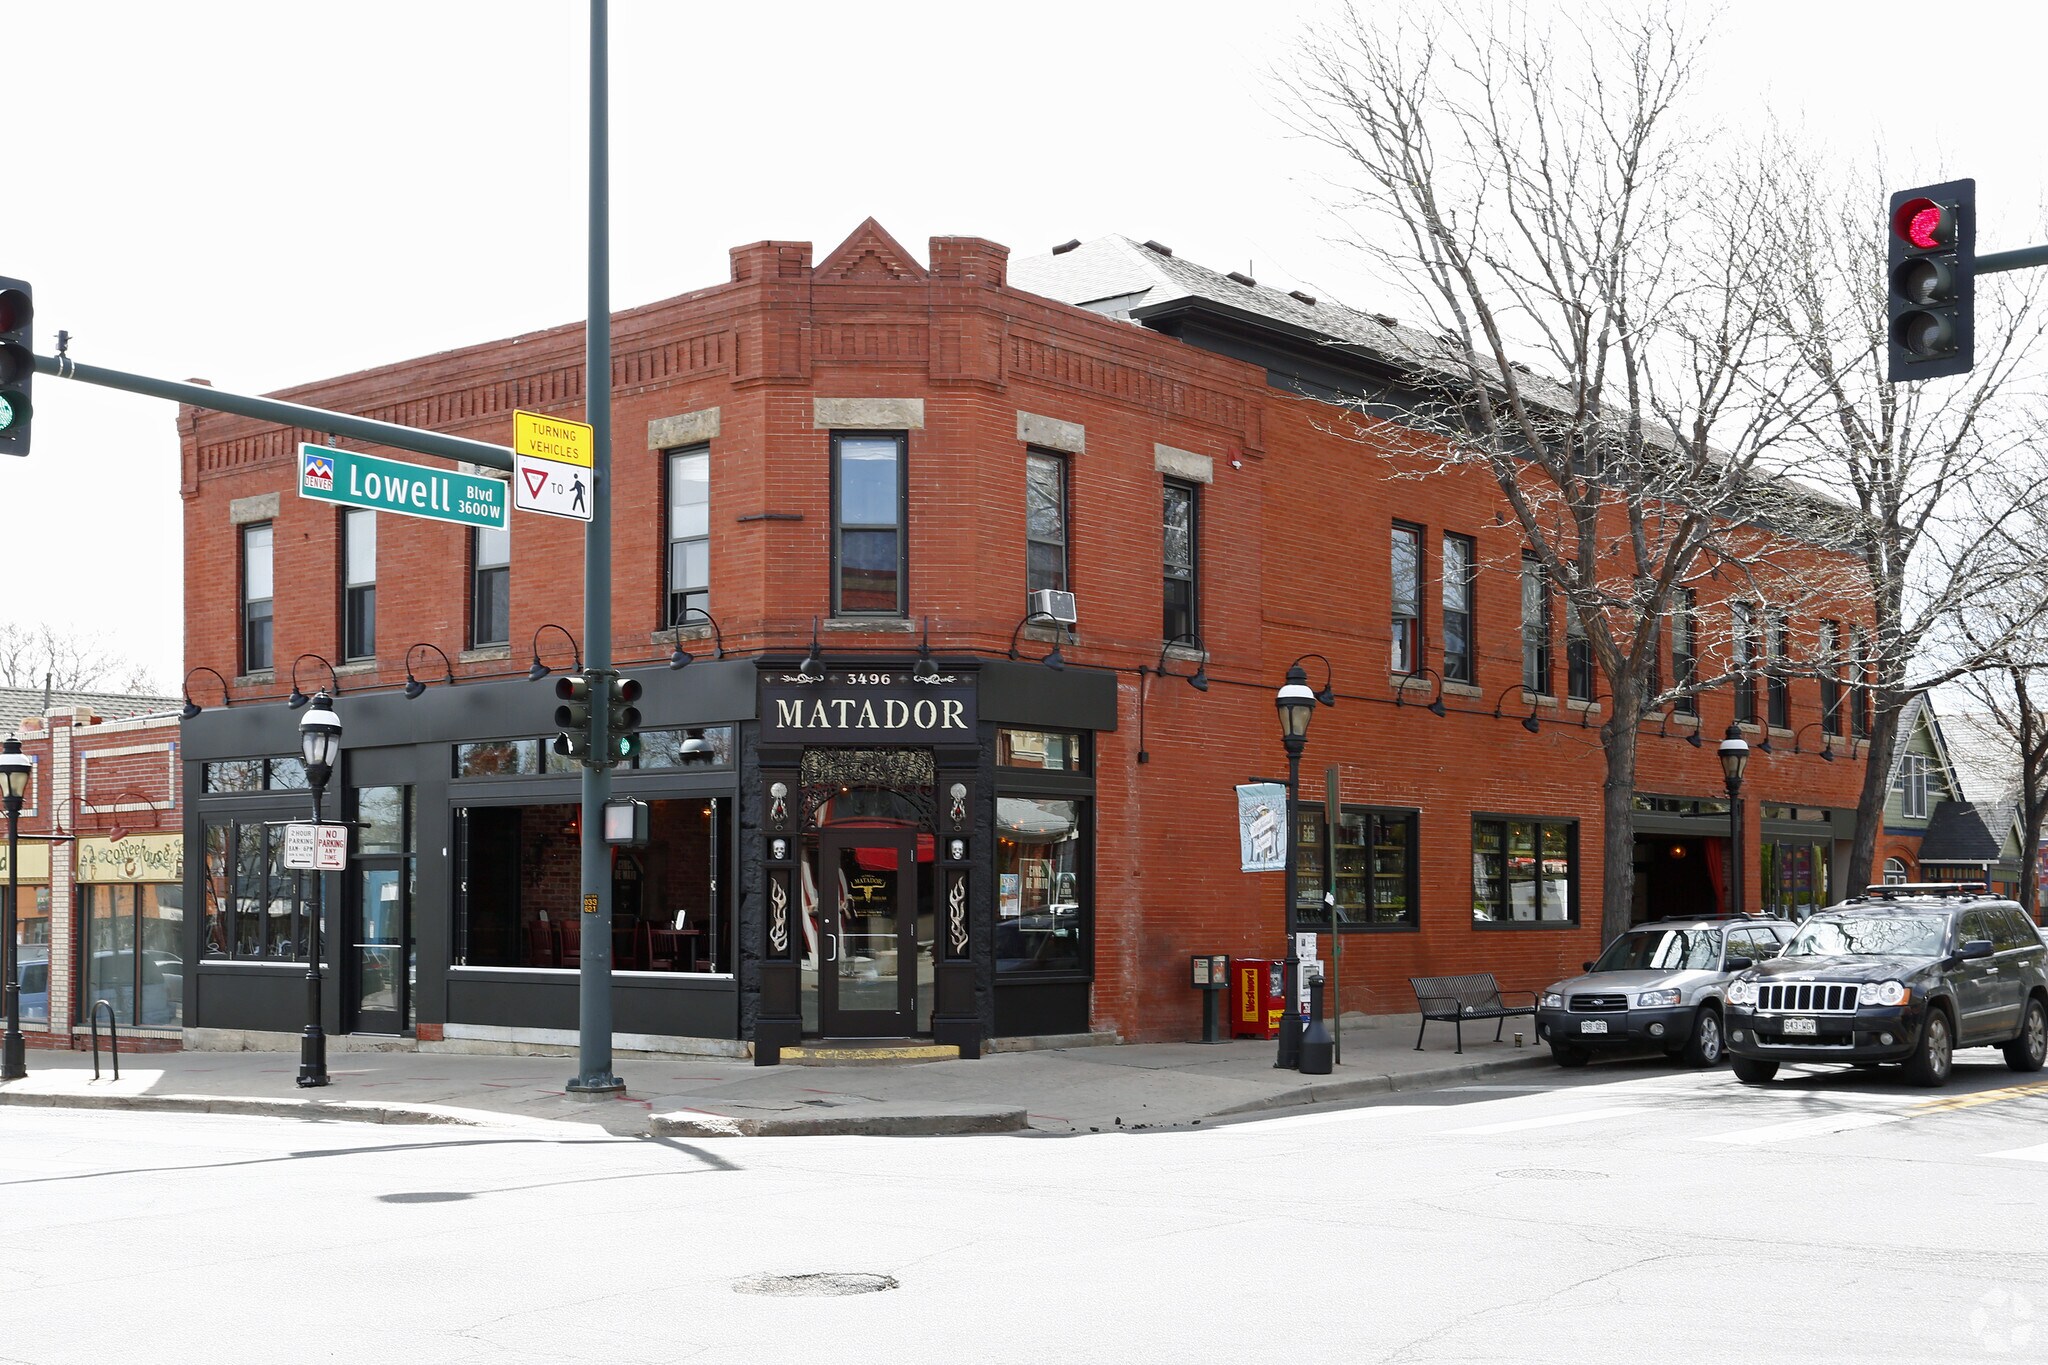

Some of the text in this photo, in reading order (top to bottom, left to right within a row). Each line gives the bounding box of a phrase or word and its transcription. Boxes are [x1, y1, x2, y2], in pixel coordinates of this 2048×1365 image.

[532, 423, 576, 441] TURNING
[530, 440, 579, 459] VEHICLES
[304, 475, 333, 490] DENVER
[350, 463, 450, 512] Lowell
[551, 482, 564, 495] TO
[466, 485, 493, 502] Blvd
[846, 673, 891, 685] 3496
[775, 698, 969, 729] MATADOR
[326, 830, 337, 838] NO
[105, 839, 170, 865] coffeehouse
[1245, 969, 1255, 1013] Westword
